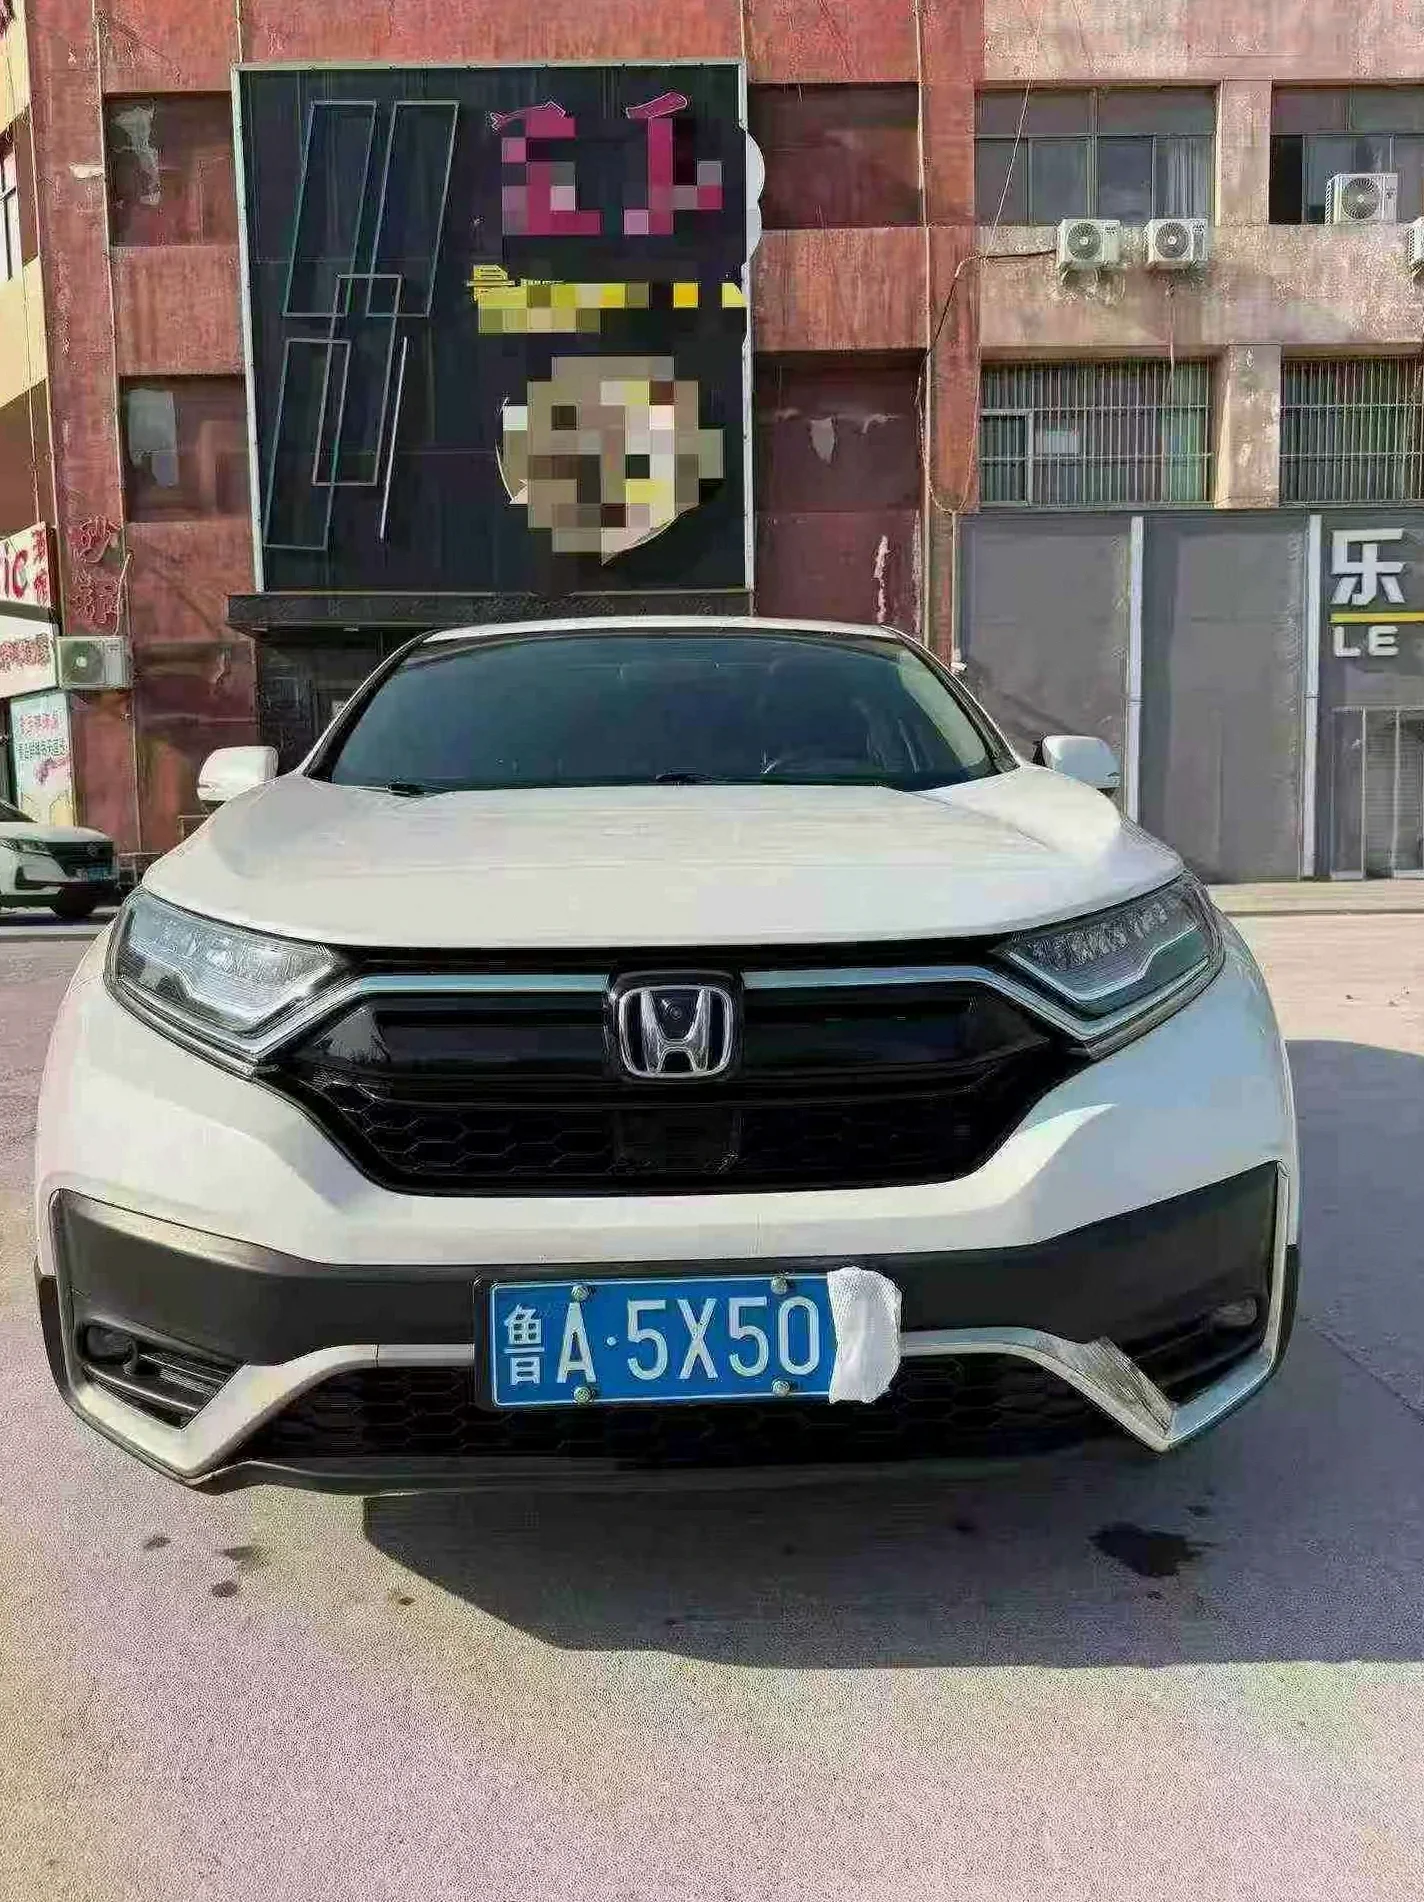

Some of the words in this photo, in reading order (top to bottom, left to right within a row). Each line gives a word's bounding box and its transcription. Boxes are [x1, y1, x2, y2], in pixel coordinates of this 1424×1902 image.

[1330, 528, 1406, 605] 乐
[1334, 625, 1400, 657] LE
[504, 1296, 820, 1386] 鲁A·5X50
